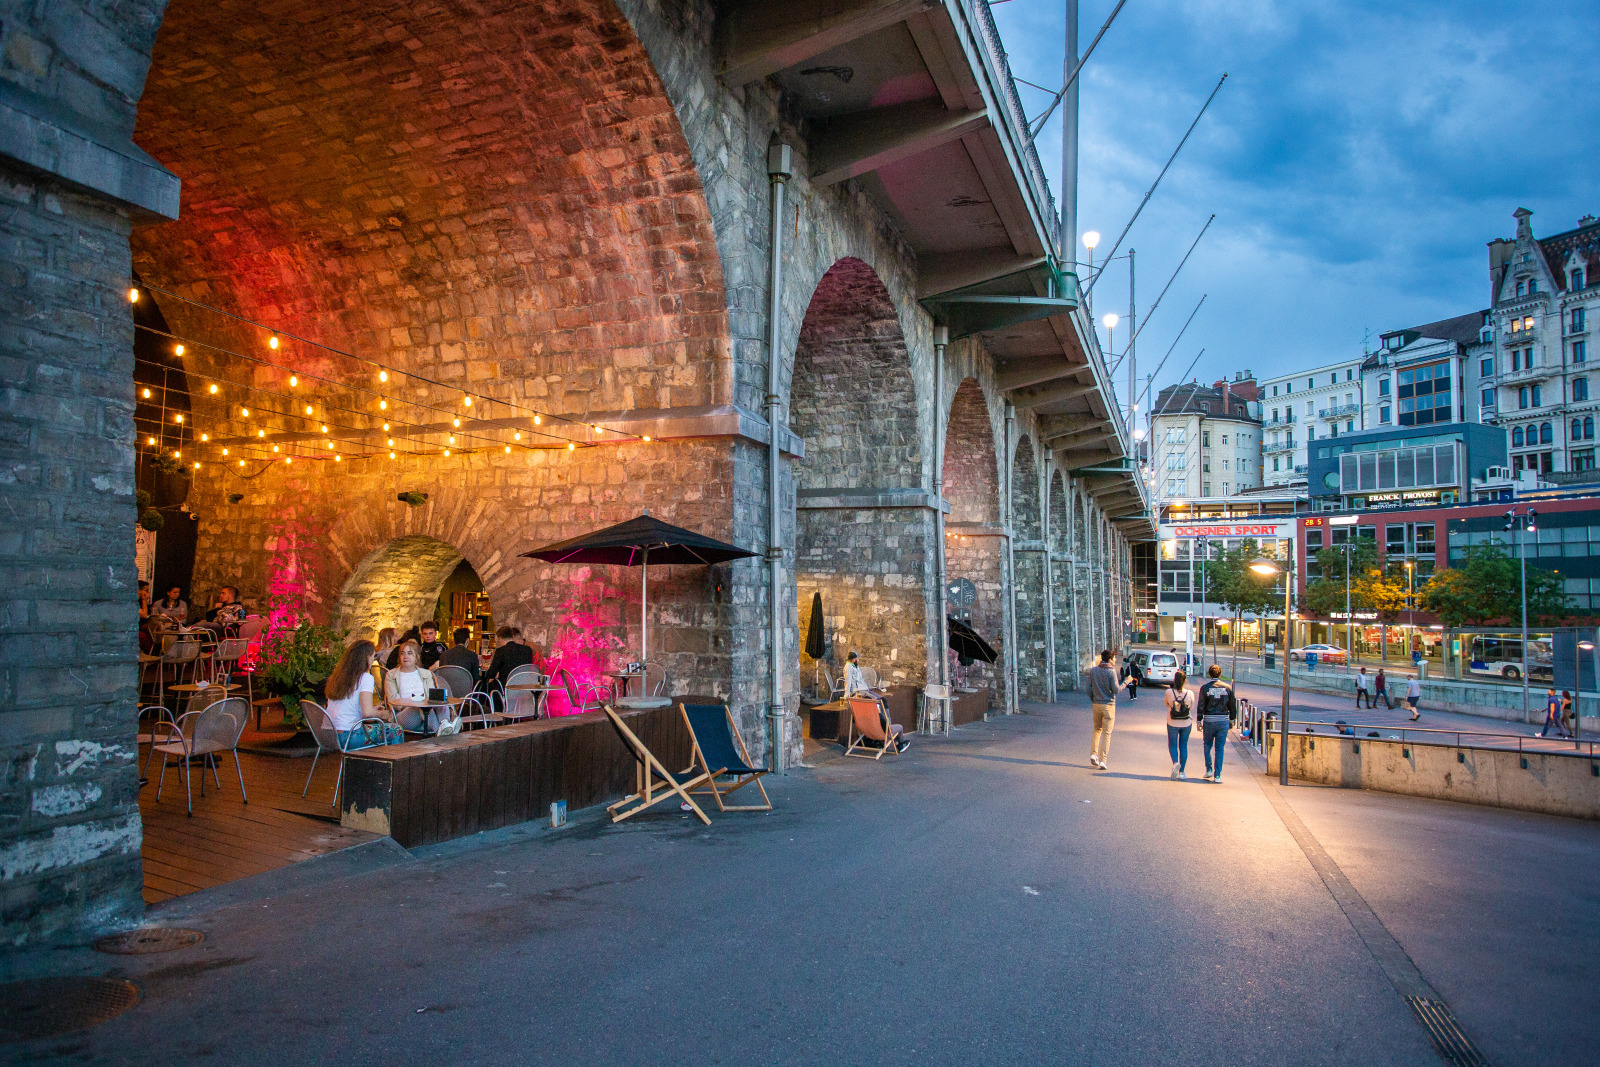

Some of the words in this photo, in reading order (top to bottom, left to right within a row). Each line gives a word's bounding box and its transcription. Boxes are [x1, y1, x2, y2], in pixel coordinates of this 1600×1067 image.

[1368, 493, 1400, 502] FRANCK
[1402, 491, 1438, 500] PROVOST
[1174, 526, 1232, 536] OCHSNER
[1235, 525, 1277, 535] SPORT
